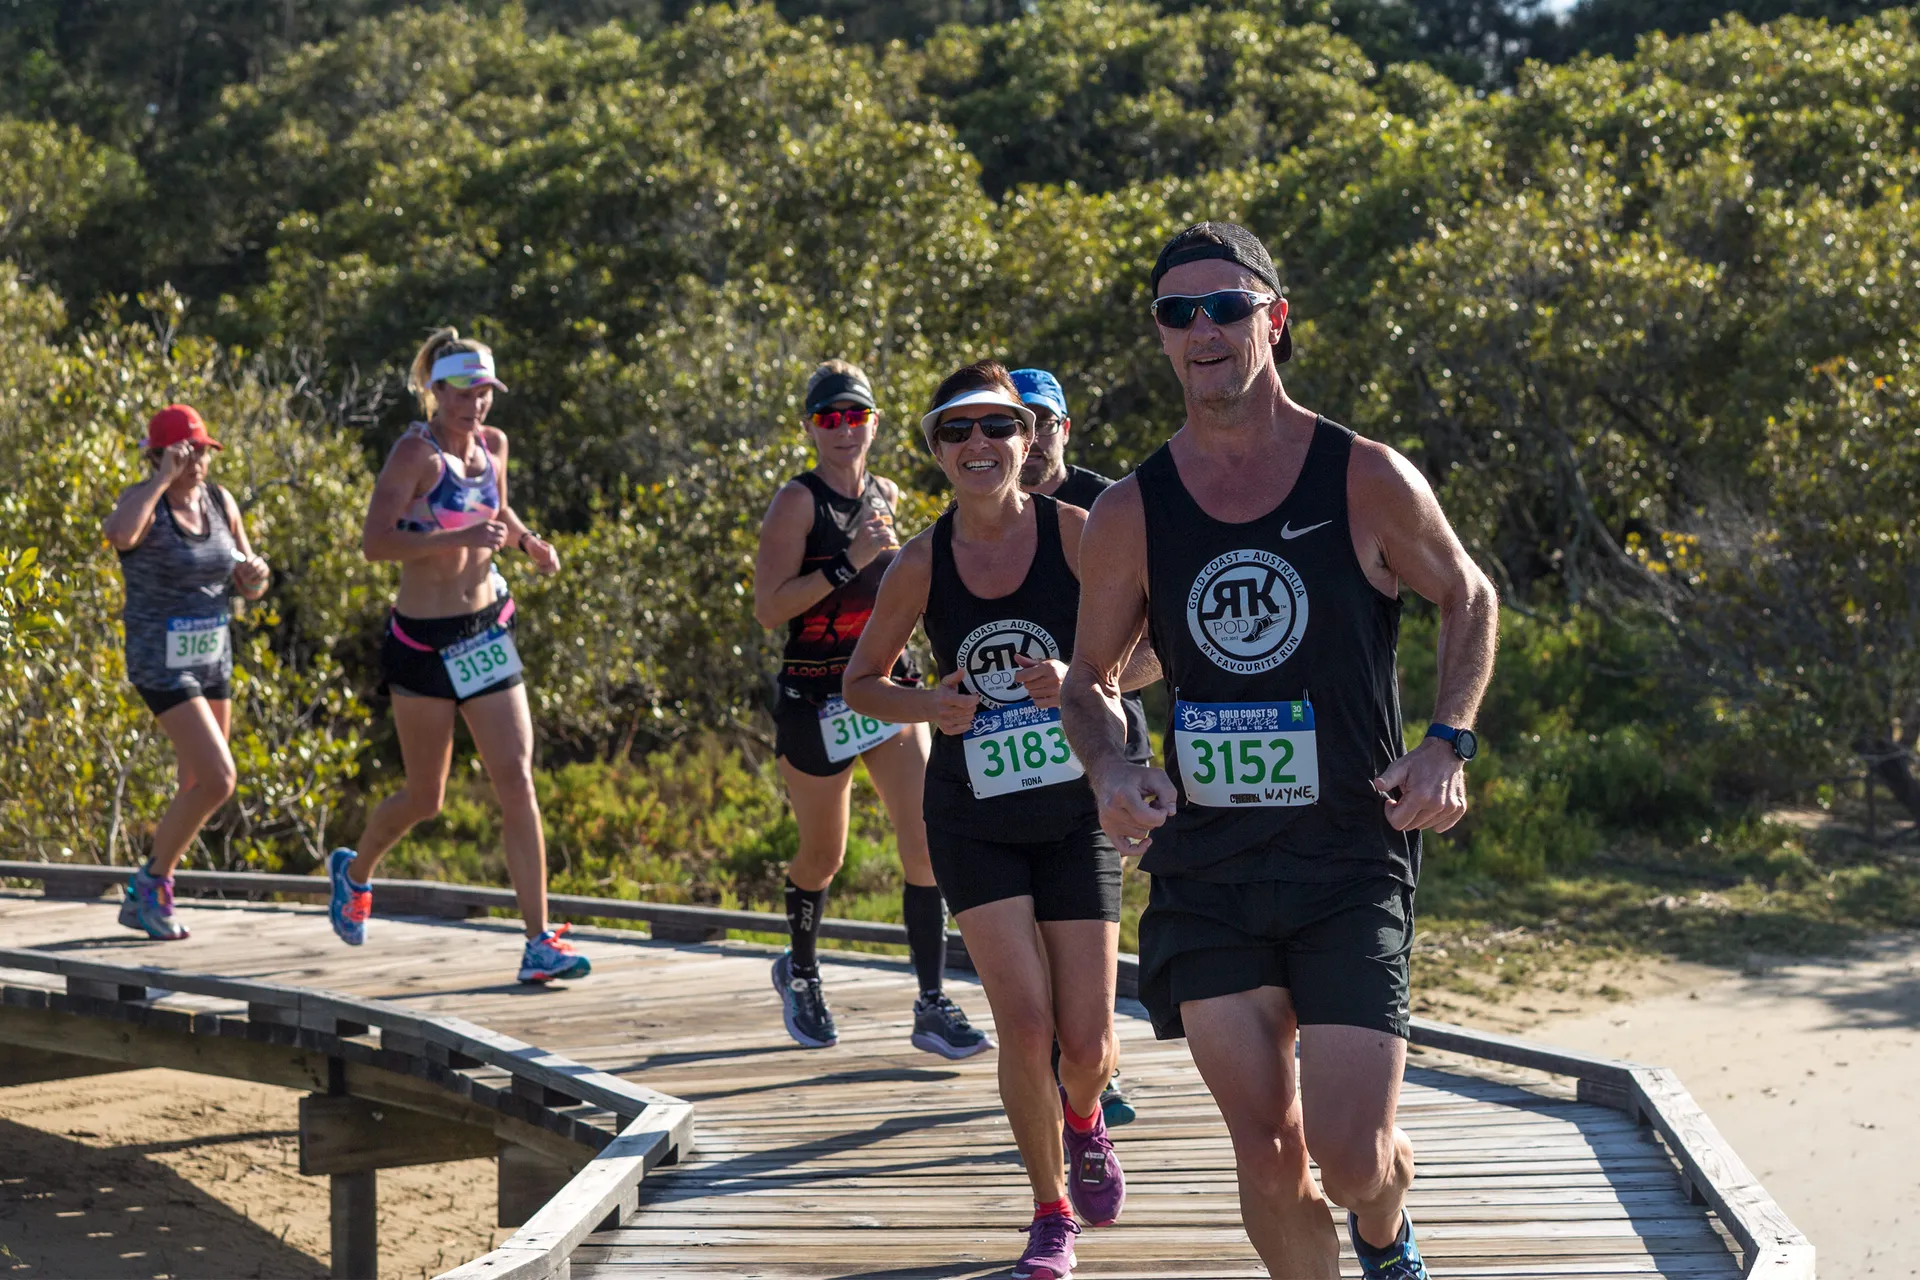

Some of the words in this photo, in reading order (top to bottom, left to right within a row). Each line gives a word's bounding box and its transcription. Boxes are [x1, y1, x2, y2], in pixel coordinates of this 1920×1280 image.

[1188, 576, 1206, 610] GOLD
[1204, 552, 1240, 576] COAST
[1253, 551, 1306, 599] AUSTRALIA
[1212, 619, 1249, 635] POD
[176, 632, 219, 657] 3165
[957, 640, 972, 668] GOLD
[969, 622, 999, 642] COAST
[1010, 621, 1057, 653] AUSTRALIA
[1200, 642, 1216, 657] MY
[1216, 655, 1280, 672] FAVOURITE
[1280, 636, 1299, 659] RUN
[455, 644, 508, 683] 3138
[981, 671, 1011, 687] POD
[1220, 709, 1239, 719] GOLD
[1240, 709, 1266, 718] COAST
[1267, 708, 1278, 717] 50
[1220, 718, 1243, 727] ROAD
[1247, 716, 1278, 727] RACES
[1292, 705, 1302, 713] 30
[832, 713, 892, 745] 316
[979, 727, 1071, 778] 3183
[1190, 738, 1297, 784] 3152
[1021, 776, 1043, 788] FIONA
[1265, 786, 1312, 804] WAYNE
